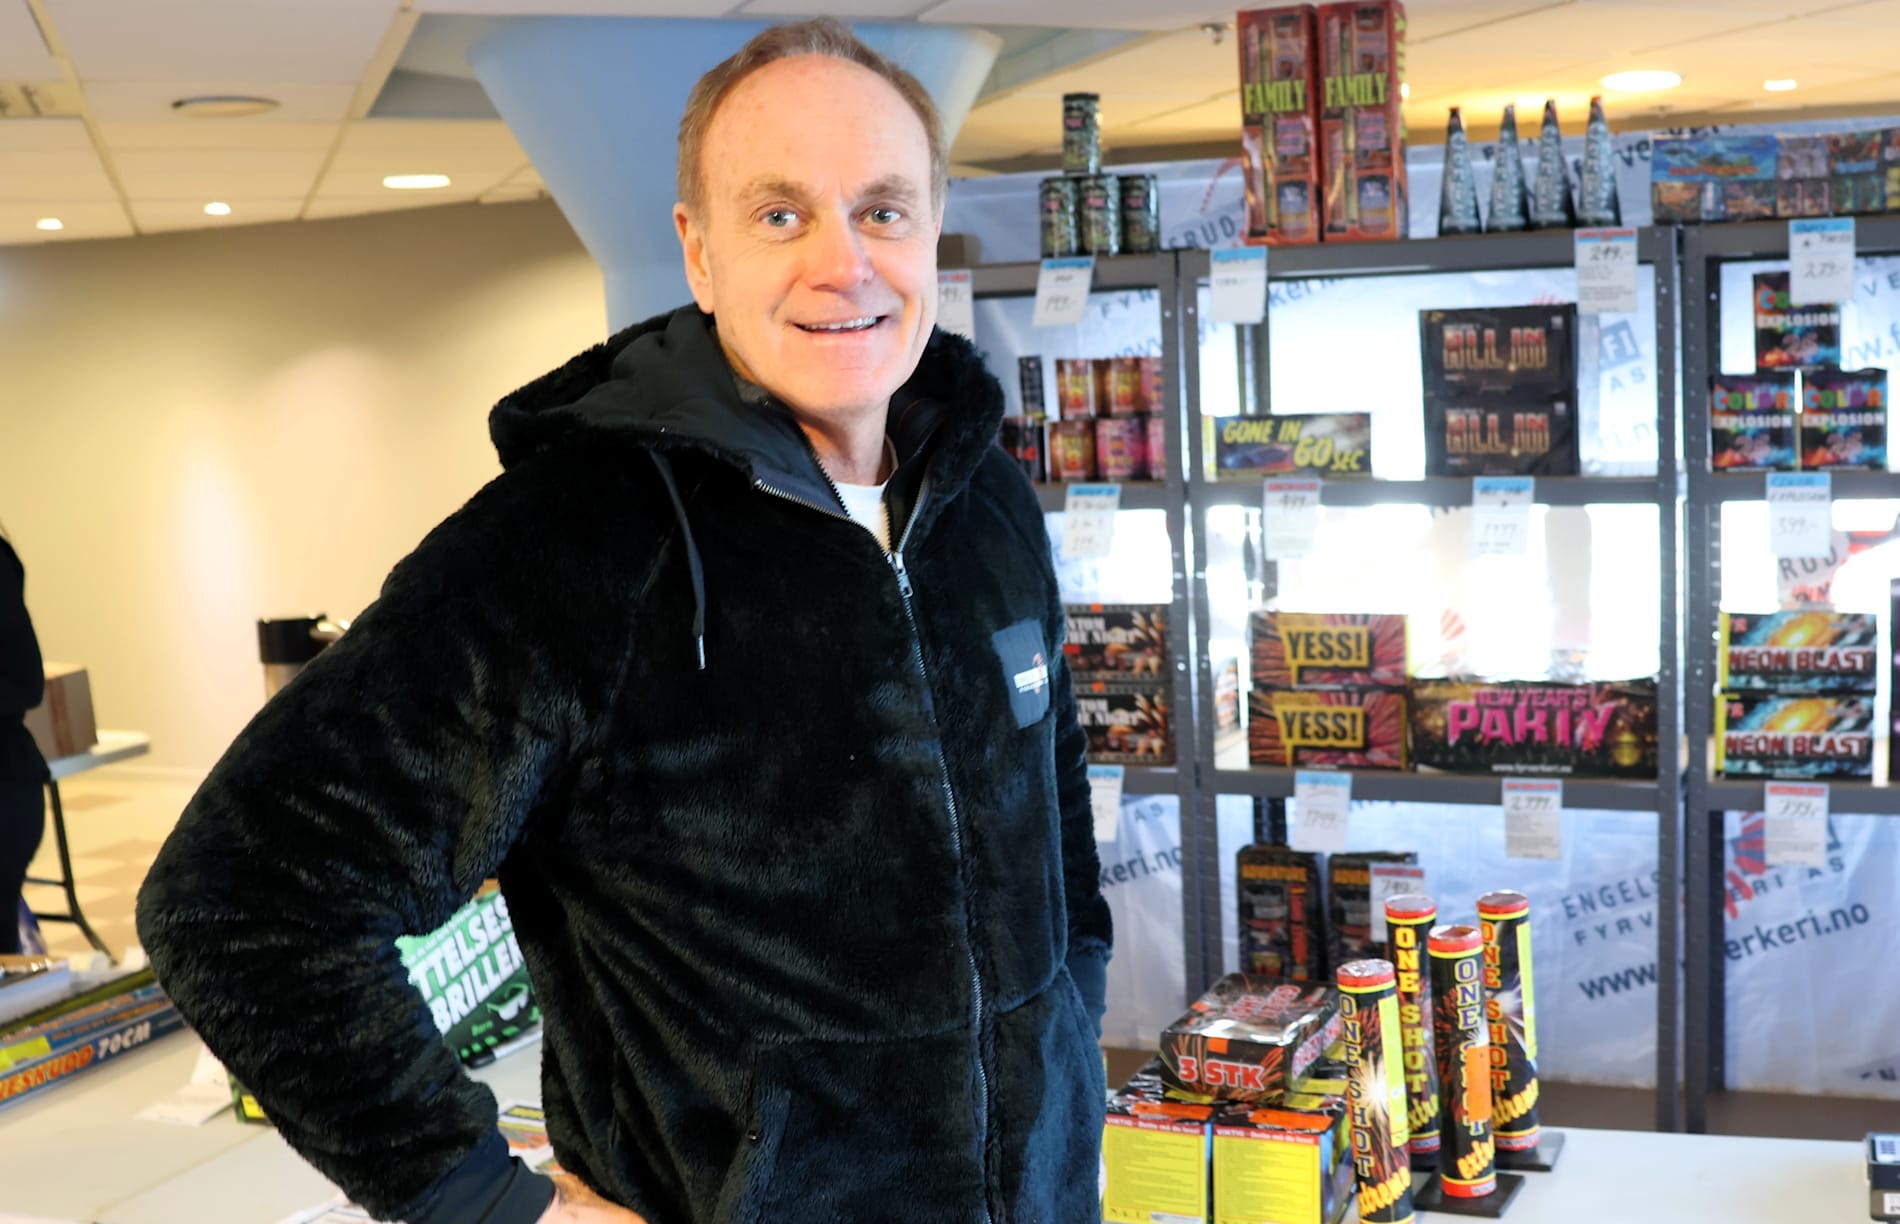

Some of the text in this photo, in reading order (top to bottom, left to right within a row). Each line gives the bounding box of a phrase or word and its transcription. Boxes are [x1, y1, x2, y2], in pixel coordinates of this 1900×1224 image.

[1244, 80, 1305, 114] FAMILY
[1325, 72, 1387, 107] FAMILY
[1756, 312, 1840, 329] EXPLOSION
[1713, 387, 1790, 411] COLOR
[1805, 386, 1882, 409] COLOR
[1223, 419, 1302, 444] GONE IN
[1712, 414, 1793, 430] EXPLOSION
[1802, 412, 1886, 428] EXPLOSION
[1294, 437, 1365, 471] 60 SEC
[1288, 631, 1363, 661] YESS!
[1729, 647, 1870, 670] NEON BLAST
[1283, 711, 1359, 741] YESS!
[1448, 698, 1618, 751] PARTY
[1725, 733, 1867, 756] NEON BLAST
[1099, 847, 1182, 889] keri.no
[408, 893, 513, 1001] TTELSES
[1725, 903, 1869, 961] erkeri.no
[1394, 926, 1421, 993] ONE
[1454, 958, 1482, 1030] ONE
[1578, 962, 1658, 1000] www
[98, 1020, 151, 1060] 70CM
[1339, 994, 1361, 1067] ONE
[1486, 999, 1511, 1091] SHOT
[1400, 1004, 1429, 1093] SHOT
[1178, 1055, 1265, 1091] 3 STK
[1349, 1079, 1376, 1178] SHOT
